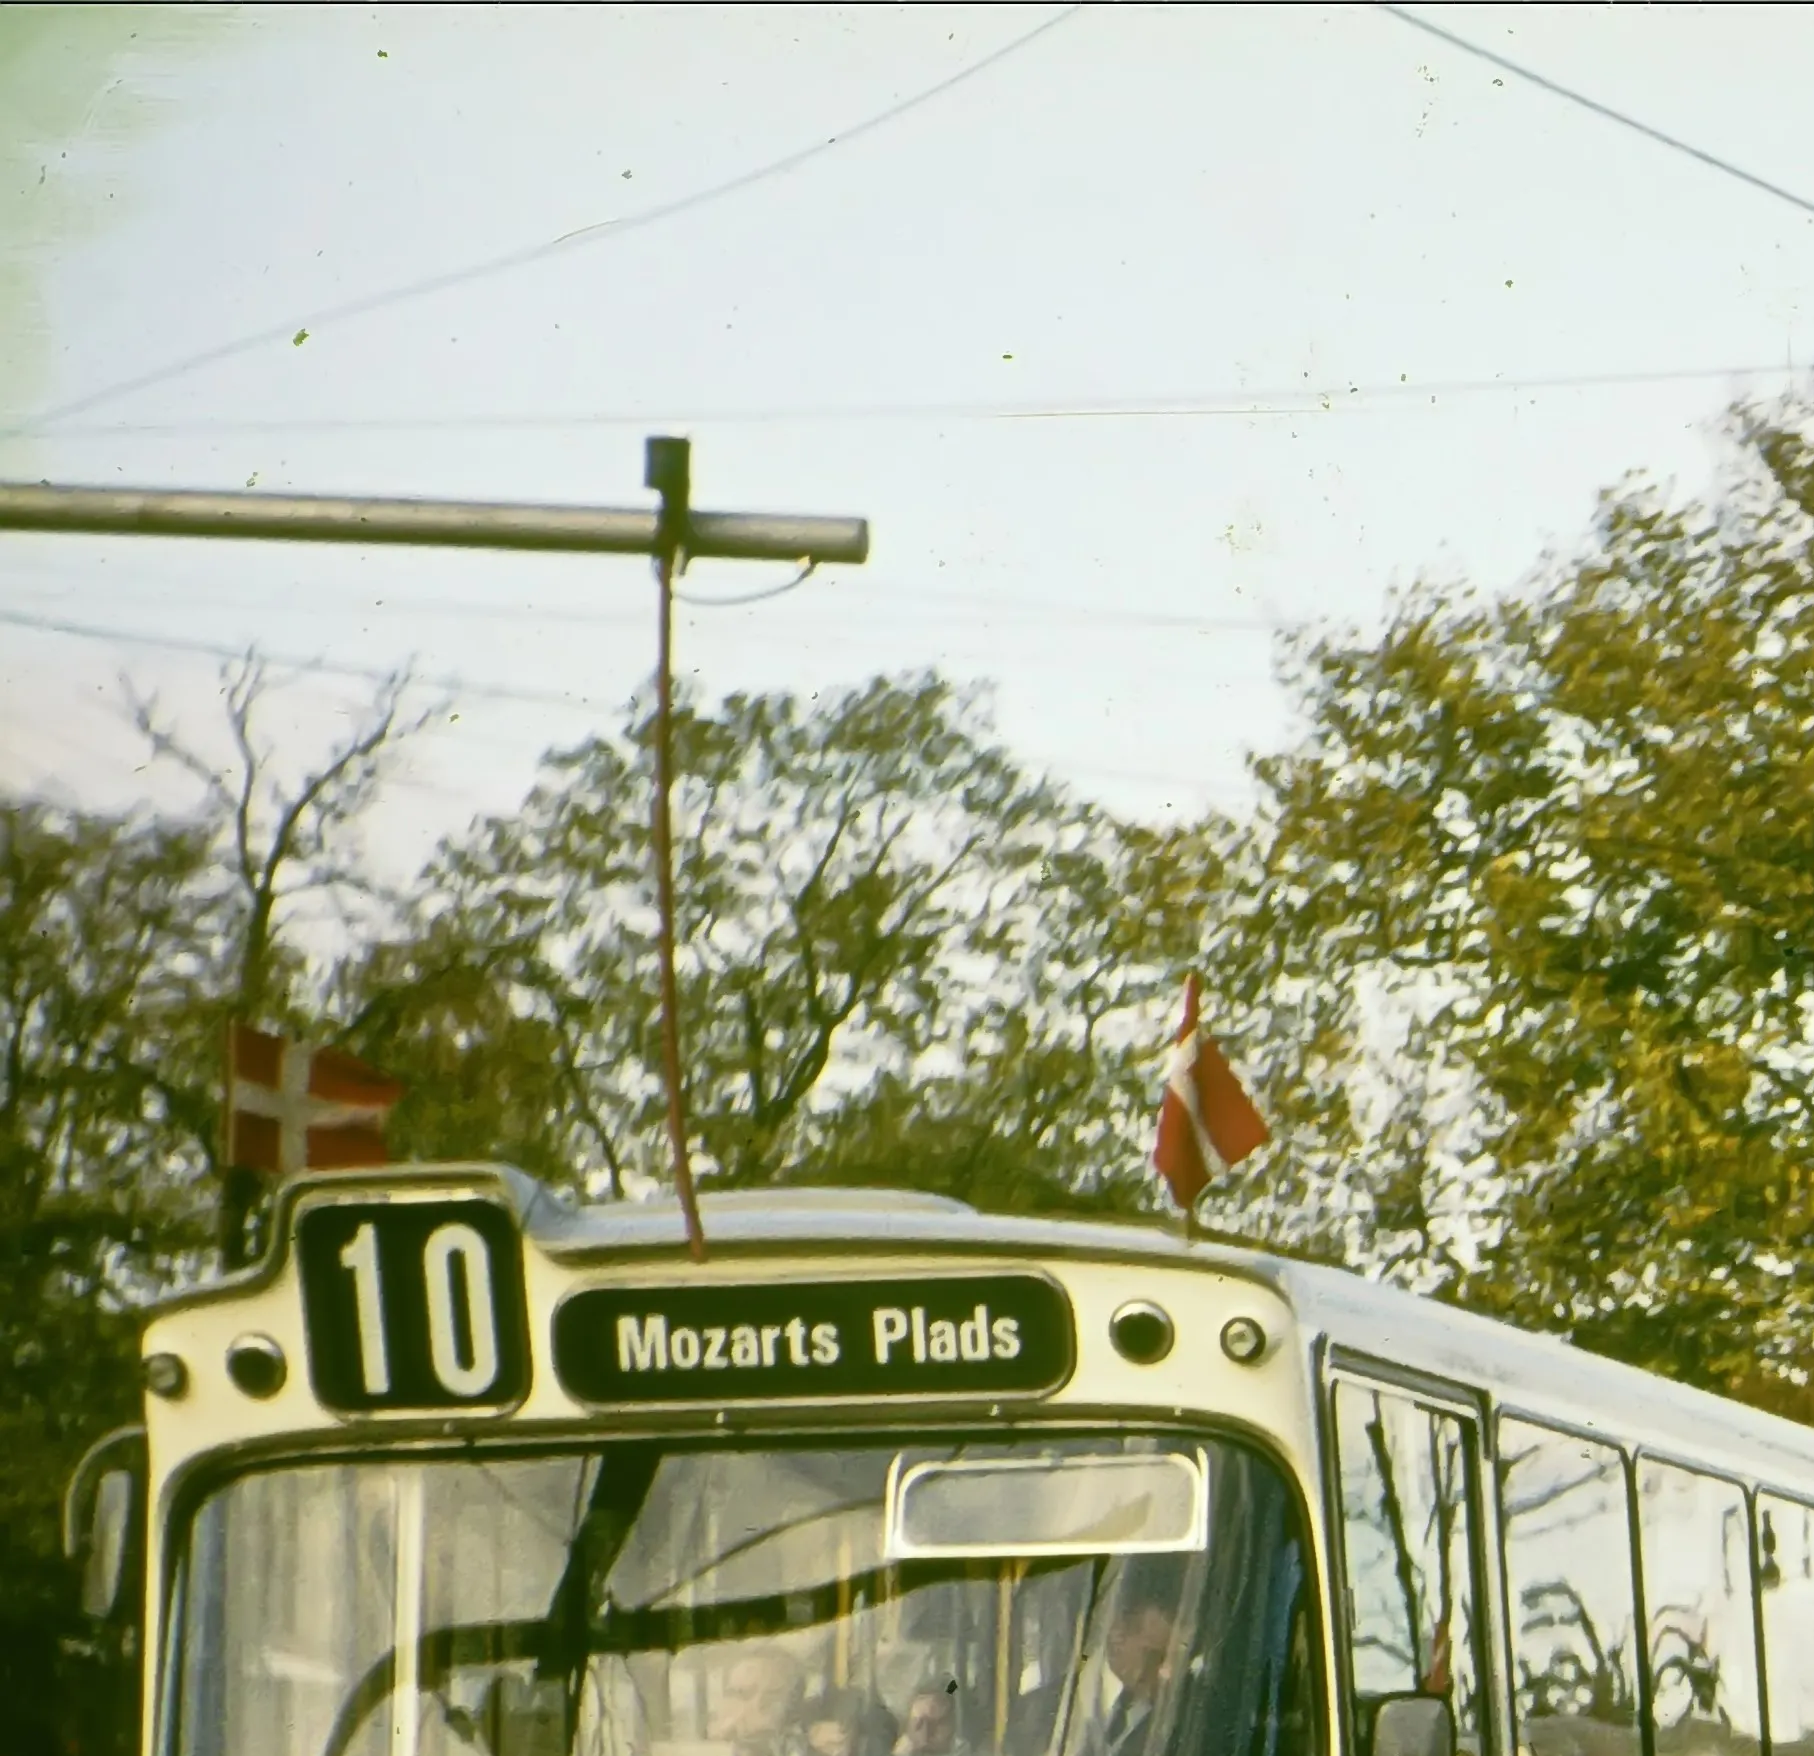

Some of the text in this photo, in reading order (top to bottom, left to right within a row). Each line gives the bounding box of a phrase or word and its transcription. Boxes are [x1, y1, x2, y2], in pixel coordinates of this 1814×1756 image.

[339, 1222, 500, 1398] 10
[616, 1305, 1022, 1373] Mozarts Plads
